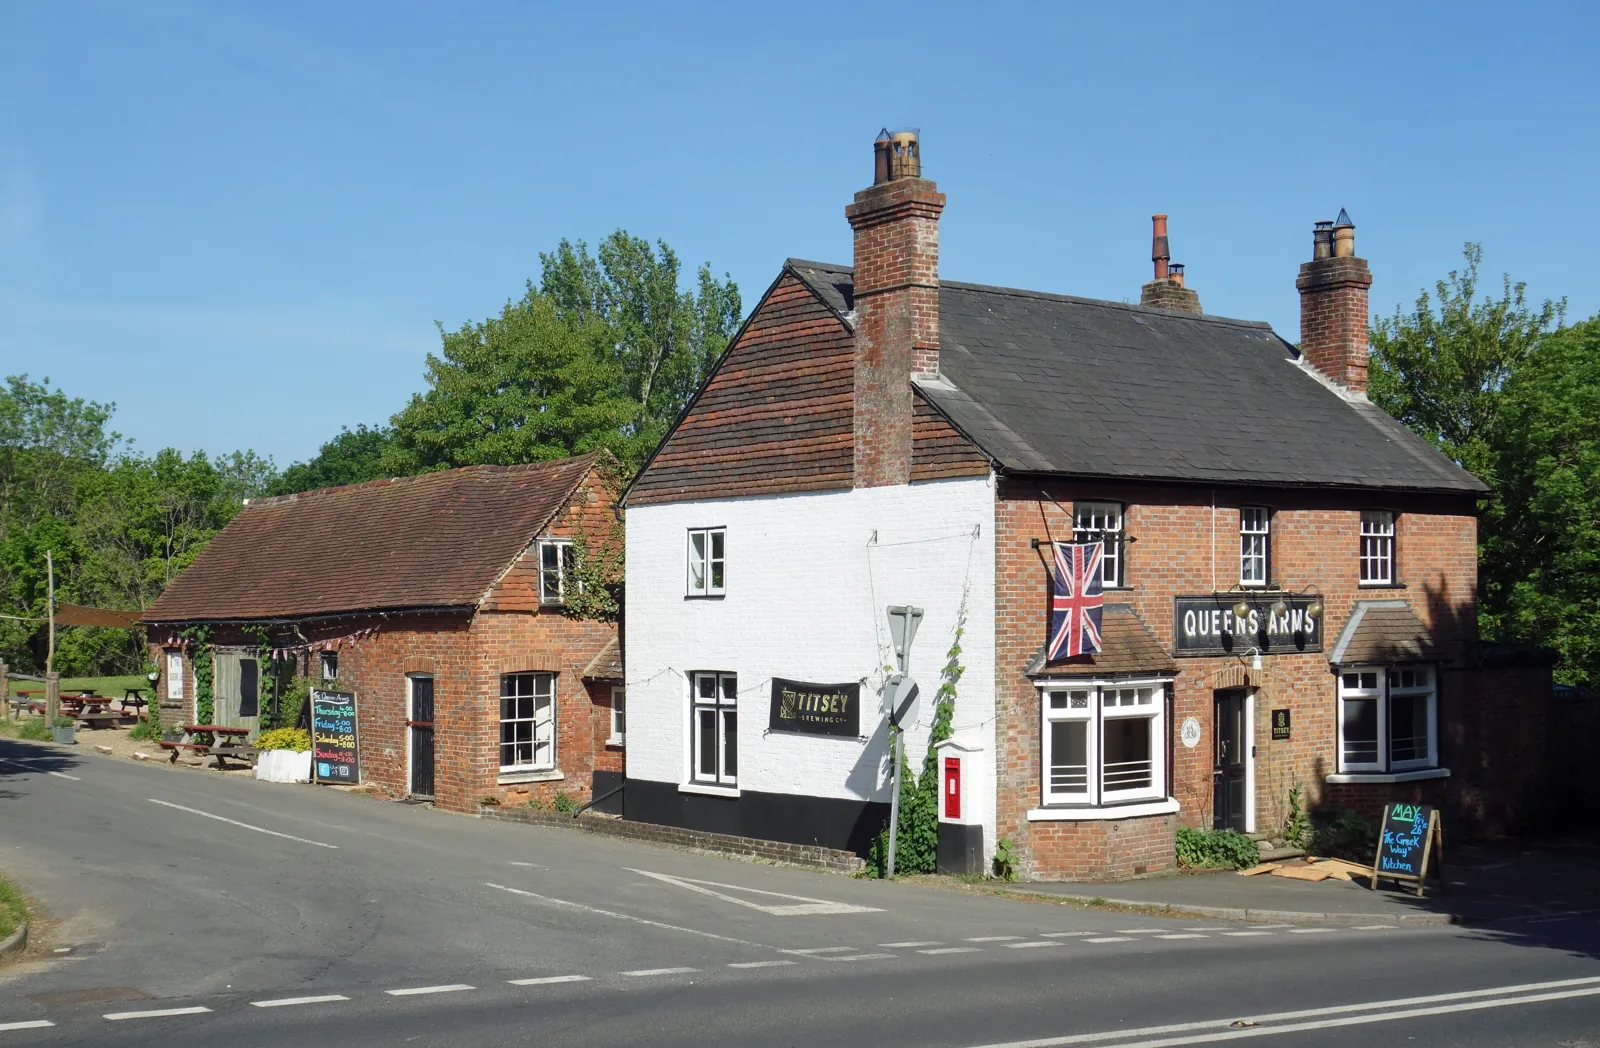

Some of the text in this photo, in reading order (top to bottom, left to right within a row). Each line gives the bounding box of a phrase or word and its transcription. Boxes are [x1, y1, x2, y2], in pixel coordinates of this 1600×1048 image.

[1184, 608, 1314, 637] QUEENS ARMS
[798, 692, 847, 713] TITSEY
[314, 705, 340, 718] Thursday
[801, 714, 833, 723] BREWING
[315, 717, 335, 731] Friday
[315, 732, 338, 747] Saturday
[316, 747, 338, 761] Sunday
[1391, 804, 1421, 818] MAY
[1414, 813, 1425, 824] Fri
[1396, 832, 1419, 847] Greek
[1382, 856, 1412, 872] Kitchen
